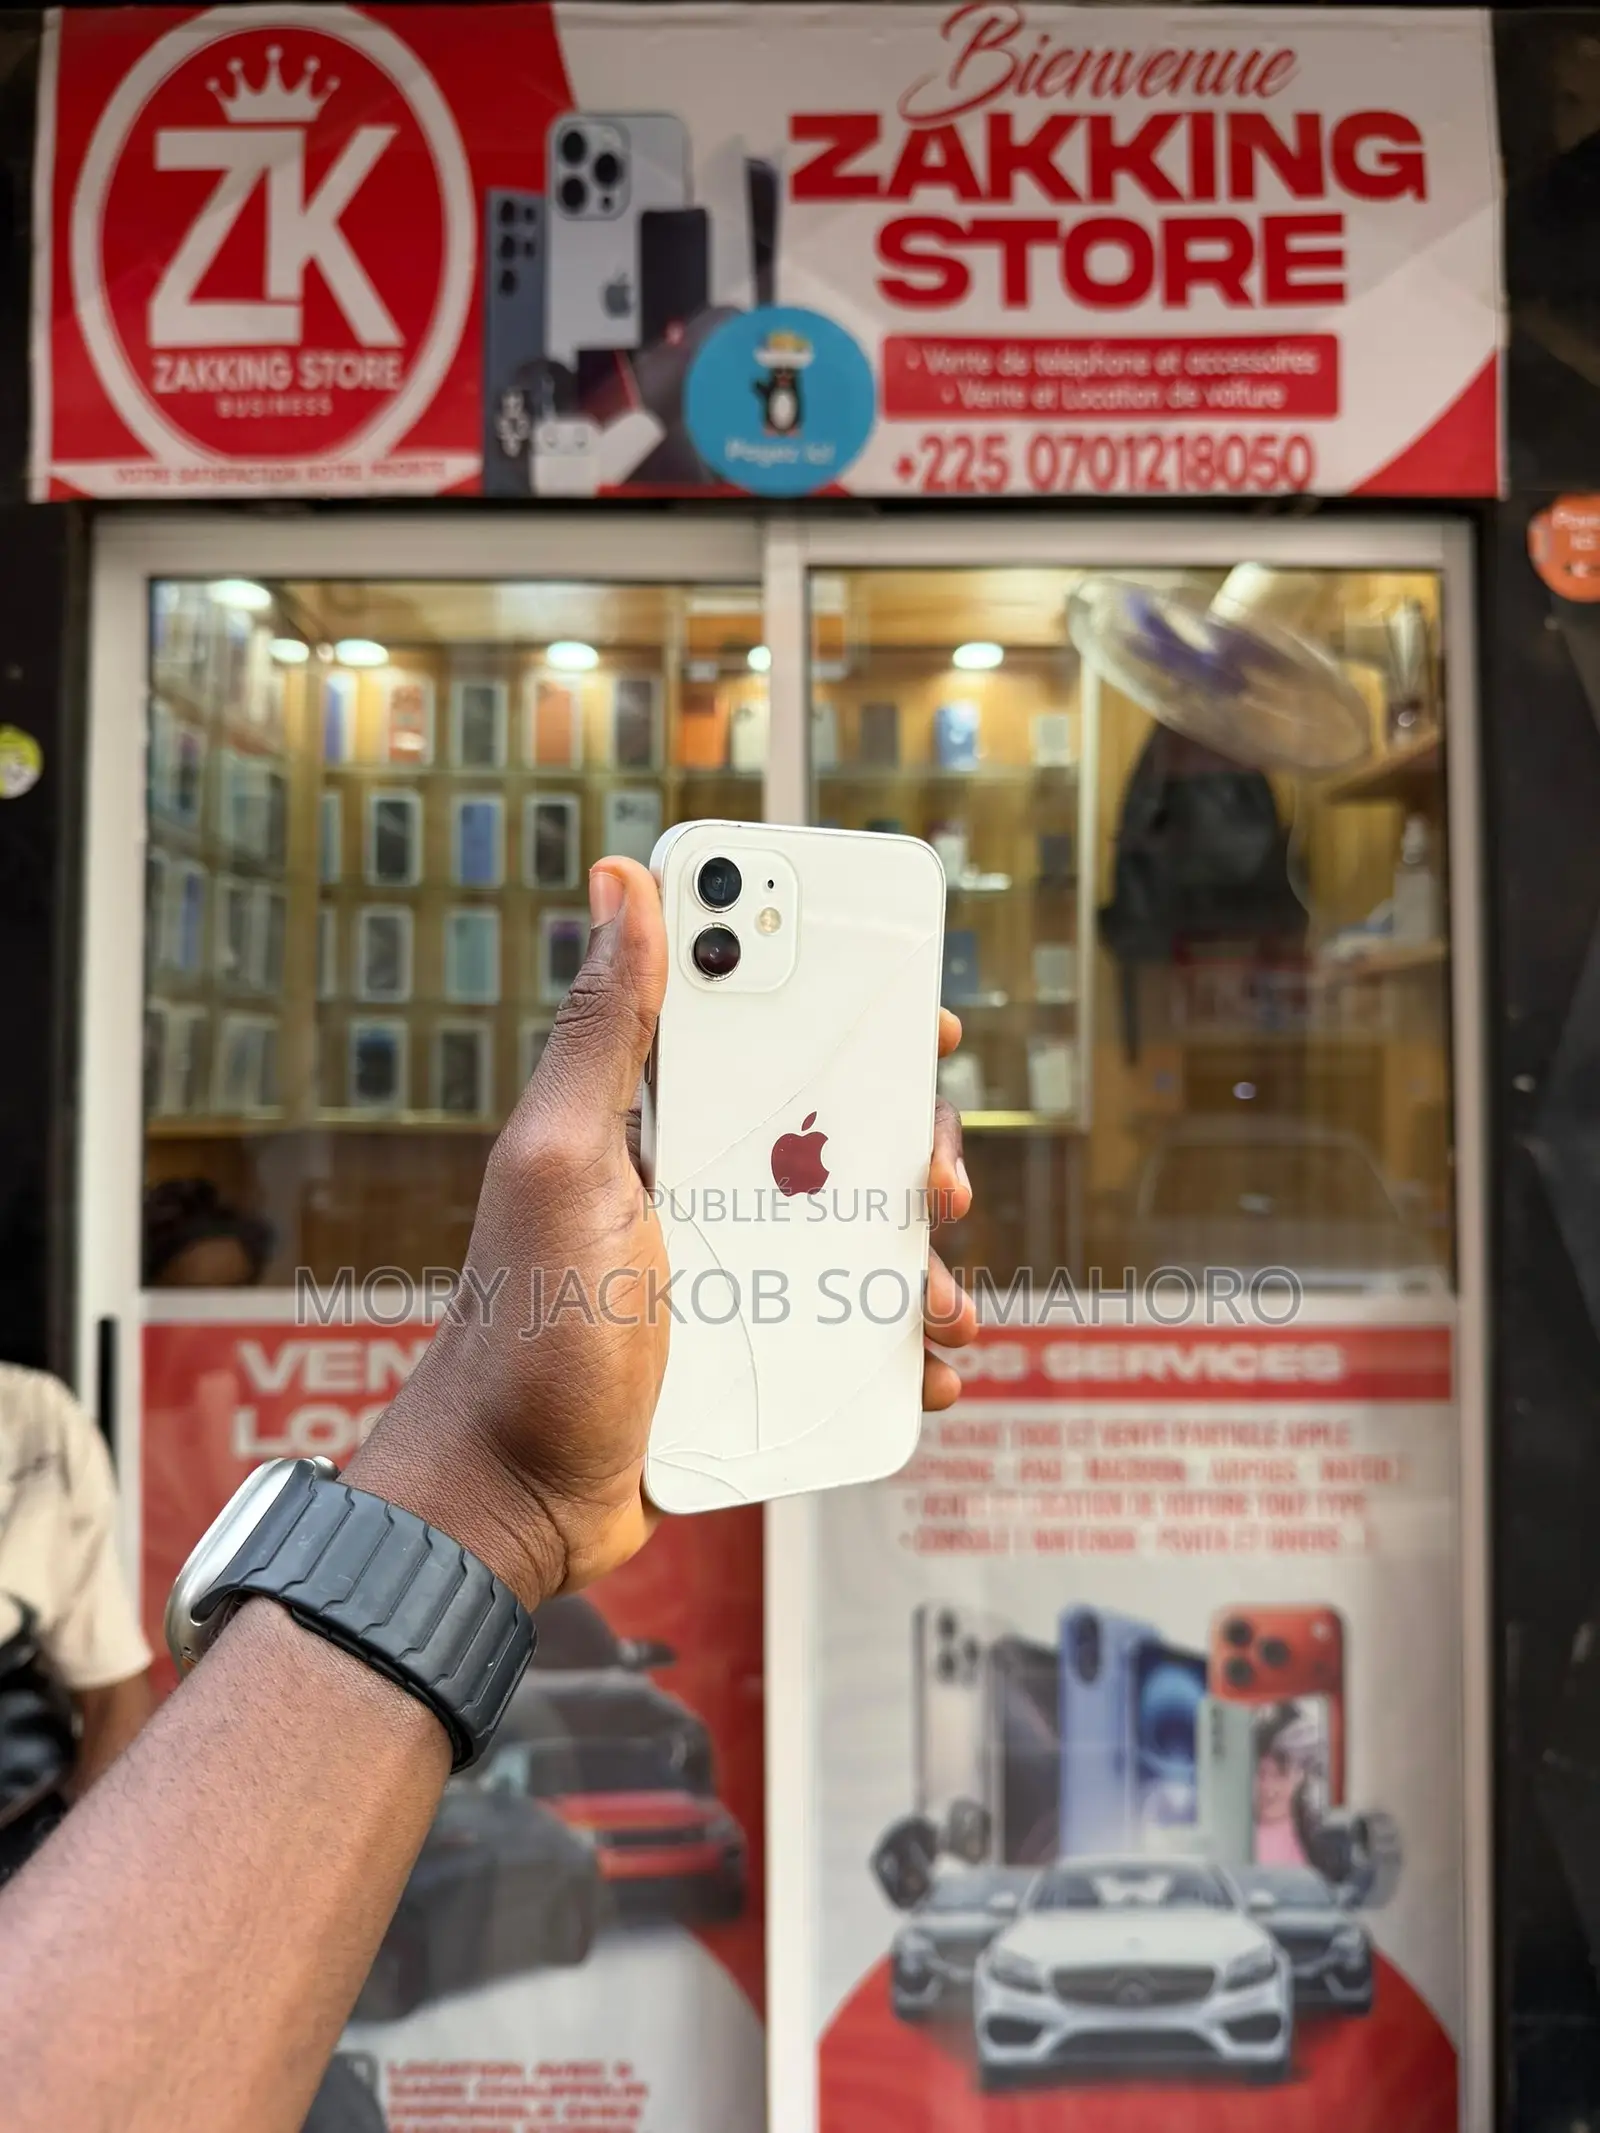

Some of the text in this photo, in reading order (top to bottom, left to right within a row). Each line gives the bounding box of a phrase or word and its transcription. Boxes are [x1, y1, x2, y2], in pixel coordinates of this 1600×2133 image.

[898, 3, 1298, 129] Bienvenue
[789, 110, 1428, 204] ZAKKING
[149, 127, 405, 347] ZK
[876, 212, 1347, 312] STORE
[152, 352, 401, 392] ZAKKING STORE
[215, 394, 333, 418] BUSINESS
[895, 433, 1316, 491] +225 0701218050
[1042, 1341, 1346, 1382] SERVICES
